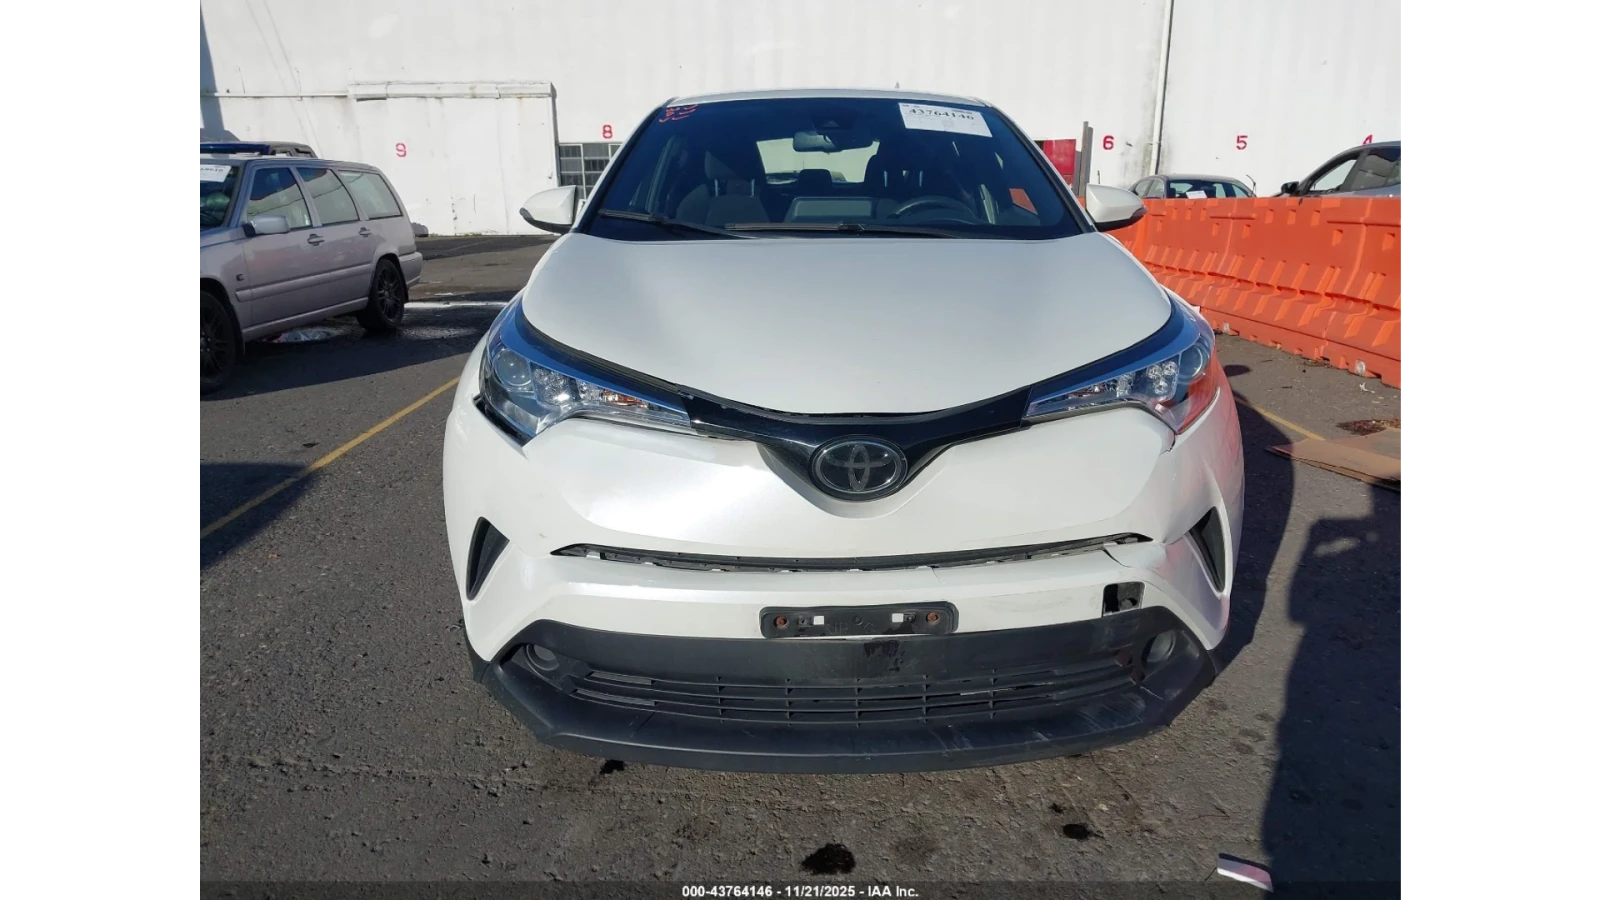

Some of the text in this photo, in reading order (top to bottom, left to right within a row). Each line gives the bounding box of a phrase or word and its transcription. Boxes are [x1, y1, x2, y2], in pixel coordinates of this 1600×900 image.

[602, 124, 613, 139] 8
[395, 142, 407, 157] 9
[1103, 135, 1114, 150] 6
[1236, 135, 1248, 150] 5
